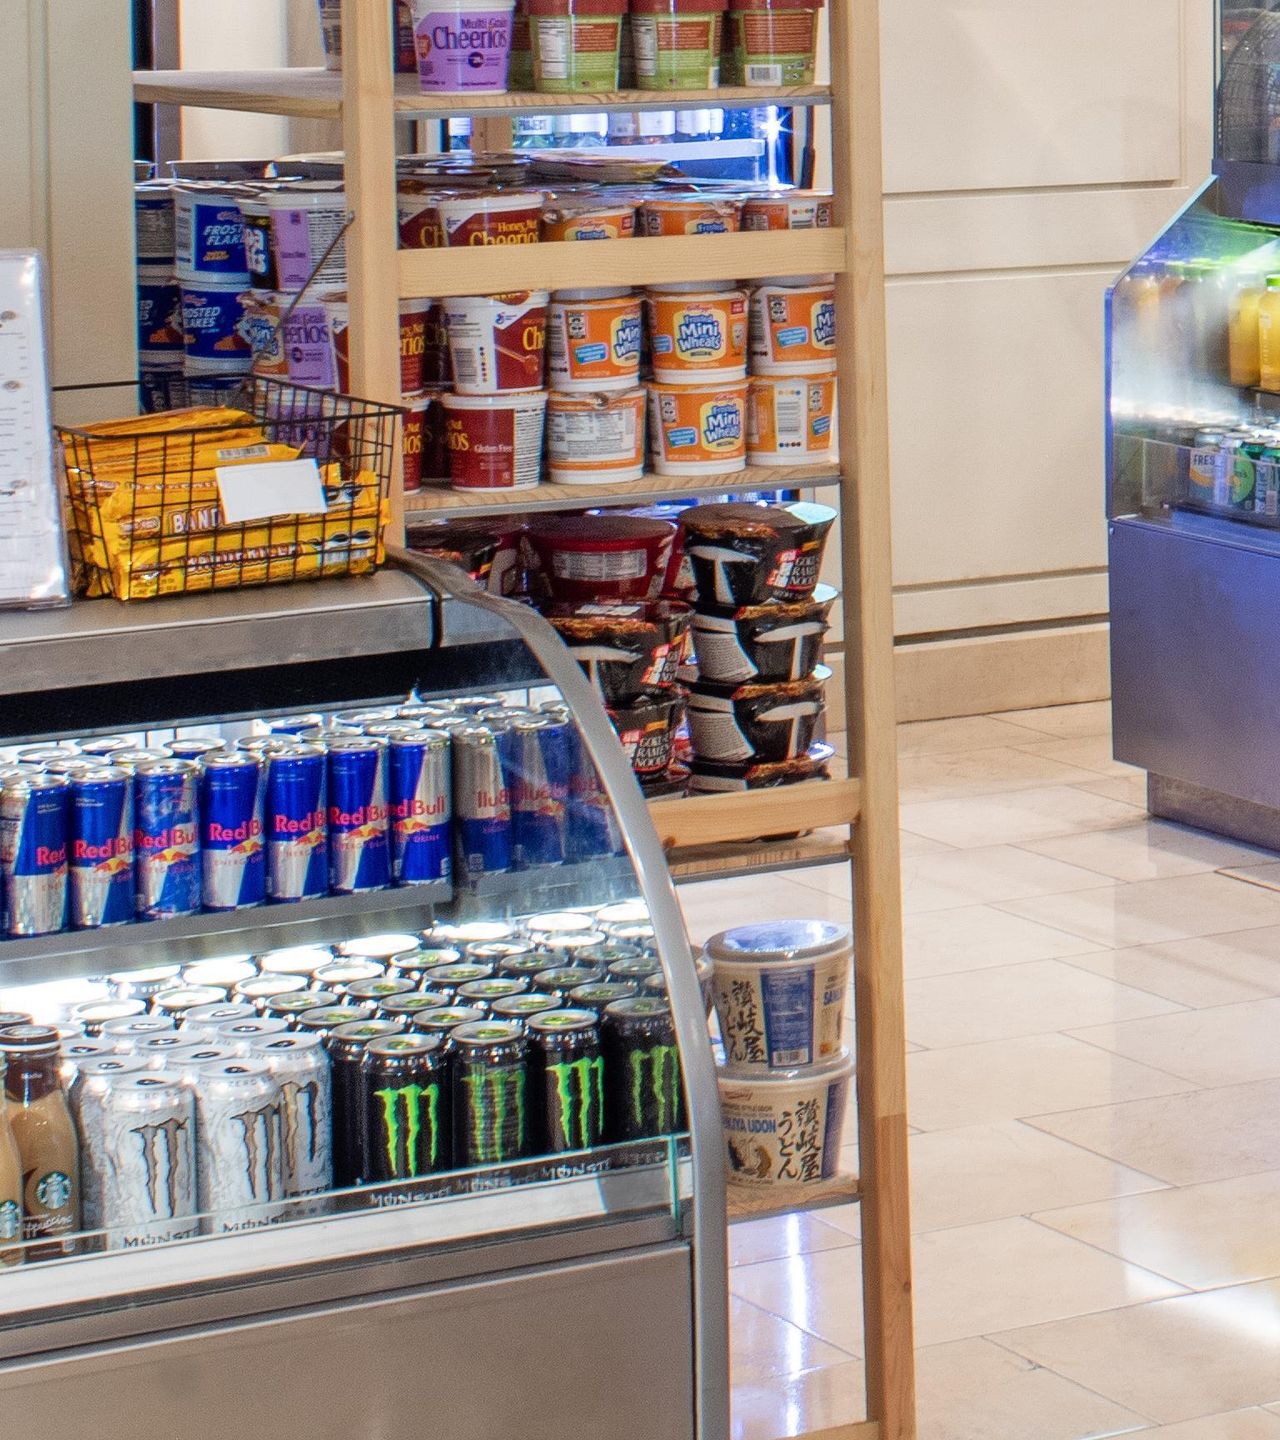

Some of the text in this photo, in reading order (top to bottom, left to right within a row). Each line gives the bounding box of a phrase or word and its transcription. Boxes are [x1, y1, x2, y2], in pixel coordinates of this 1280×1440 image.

[680, 321, 719, 338] Mini
[678, 336, 720, 351] Wheats
[708, 413, 740, 429] Mini
[331, 804, 366, 826] Red
[414, 796, 446, 817] Bull
[209, 822, 247, 842] Red
[274, 812, 313, 833] Red
[74, 838, 113, 859] Red
[135, 828, 169, 849] Red
